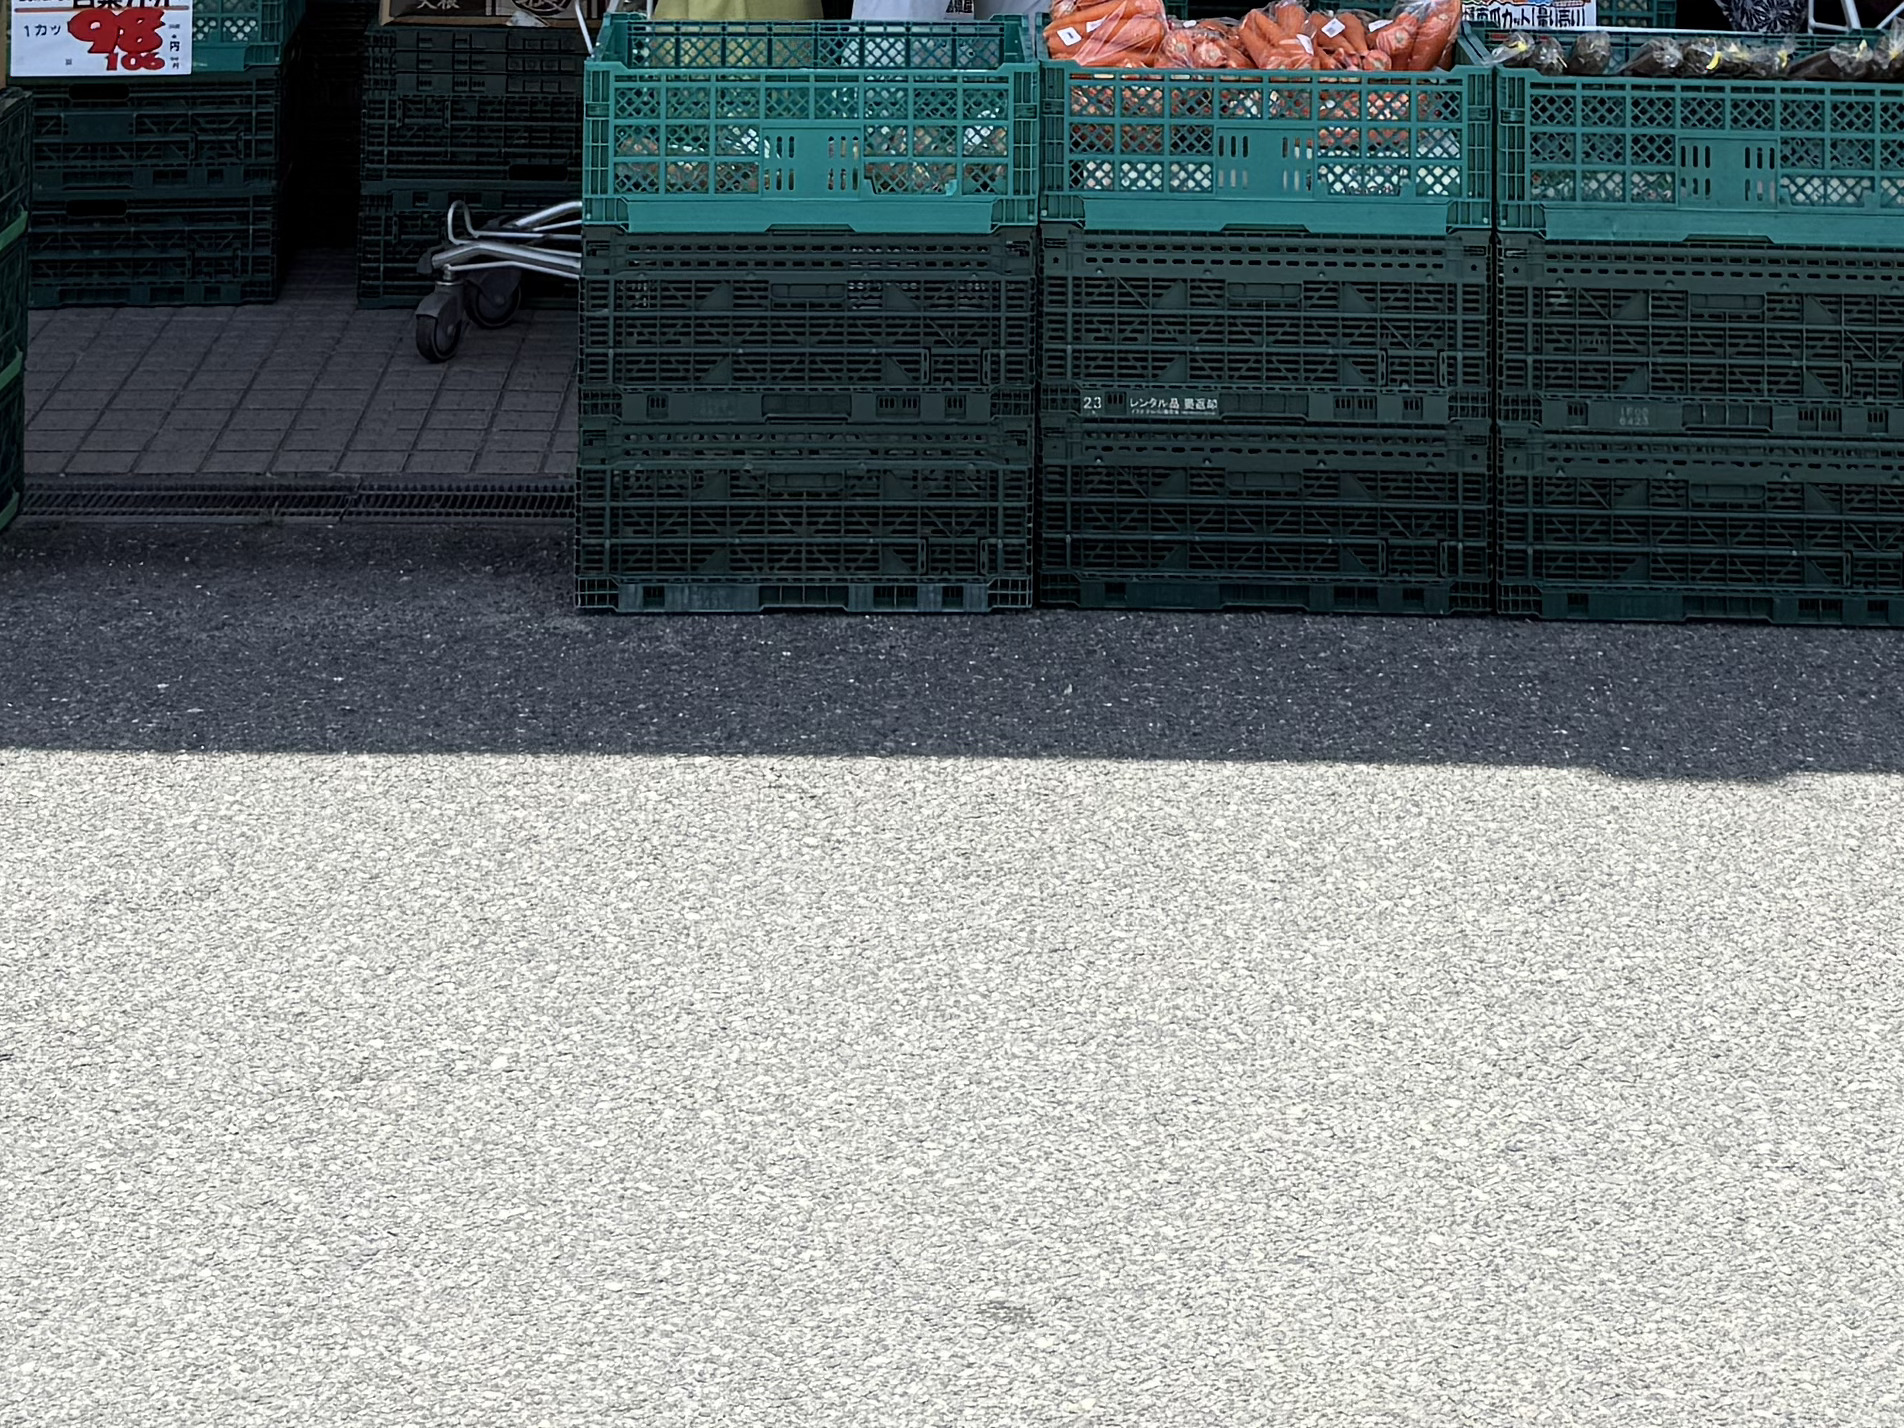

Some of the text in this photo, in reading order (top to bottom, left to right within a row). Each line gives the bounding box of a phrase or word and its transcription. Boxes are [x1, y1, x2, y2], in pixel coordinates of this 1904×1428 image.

[67, 8, 166, 54] 98
[1129, 396, 1180, 410] レンタル品
